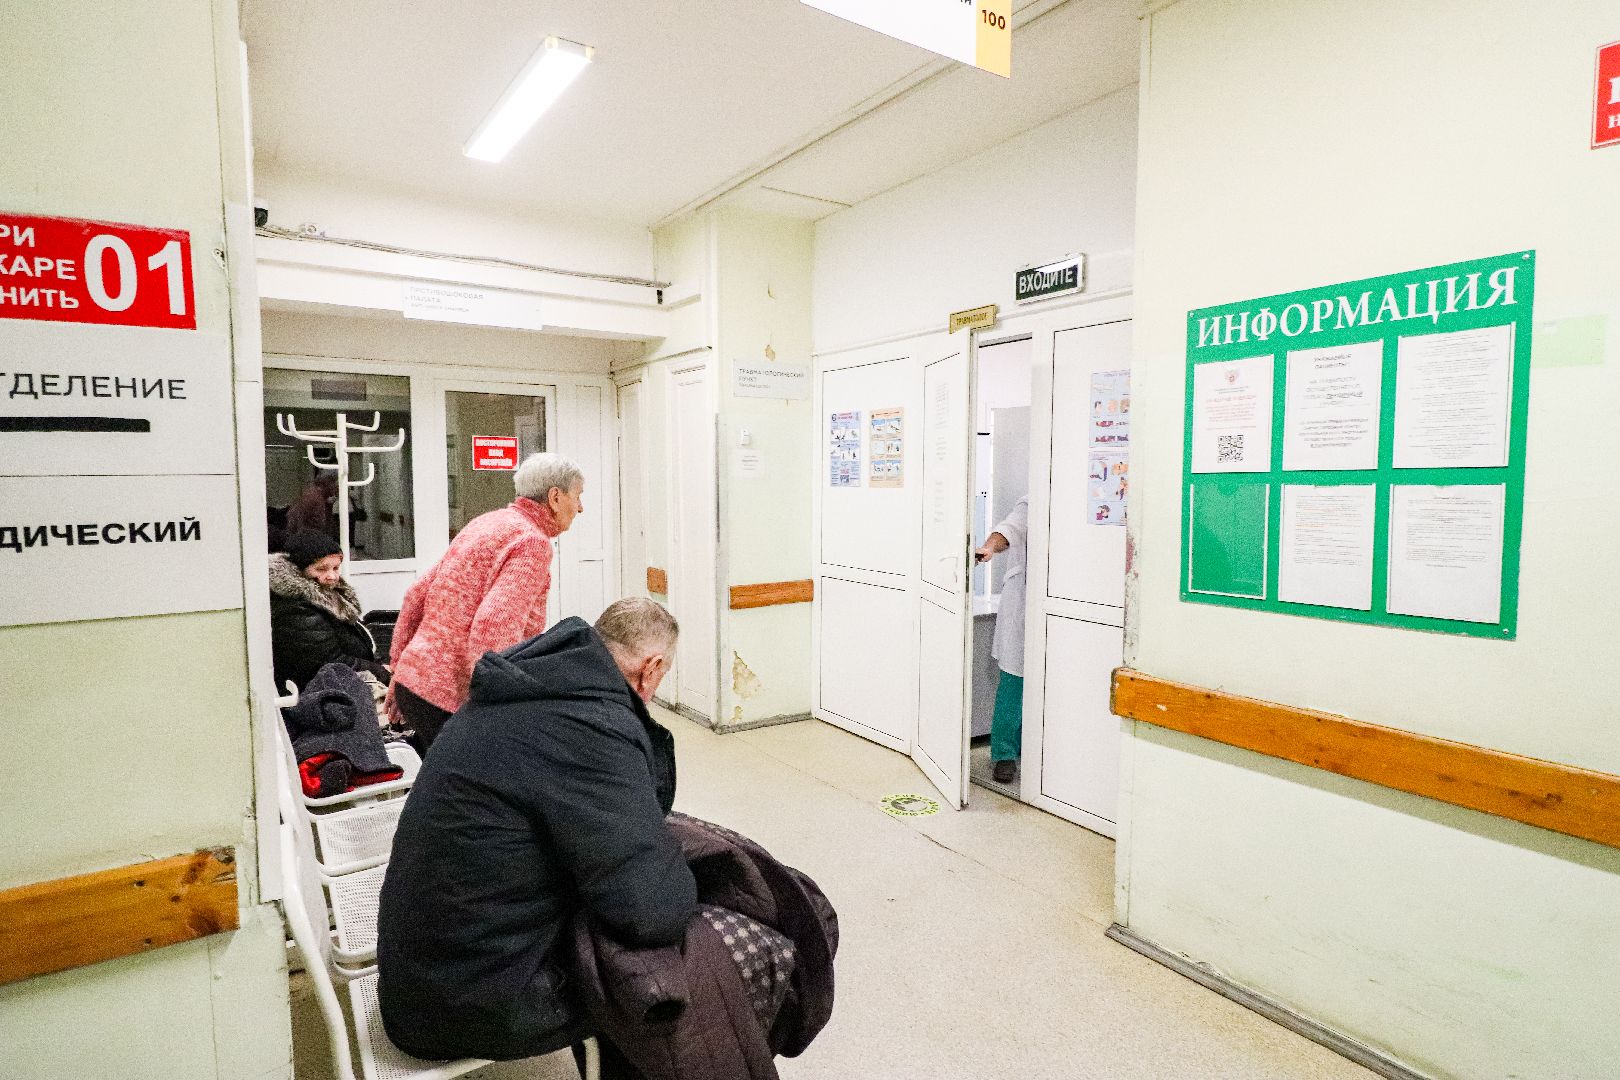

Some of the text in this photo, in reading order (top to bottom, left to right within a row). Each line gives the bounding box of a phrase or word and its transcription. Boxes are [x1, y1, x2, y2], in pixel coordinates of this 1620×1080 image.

[981, 9, 1006, 30] 100
[84, 233, 187, 316] 01
[1018, 267, 1074, 295] ВХОДИТЕ
[0, 285, 80, 309] НИТЬ
[1195, 265, 1520, 349] ИНФОРМАЦИЯ
[0, 516, 201, 553] ДИЧЕСКИЙ
